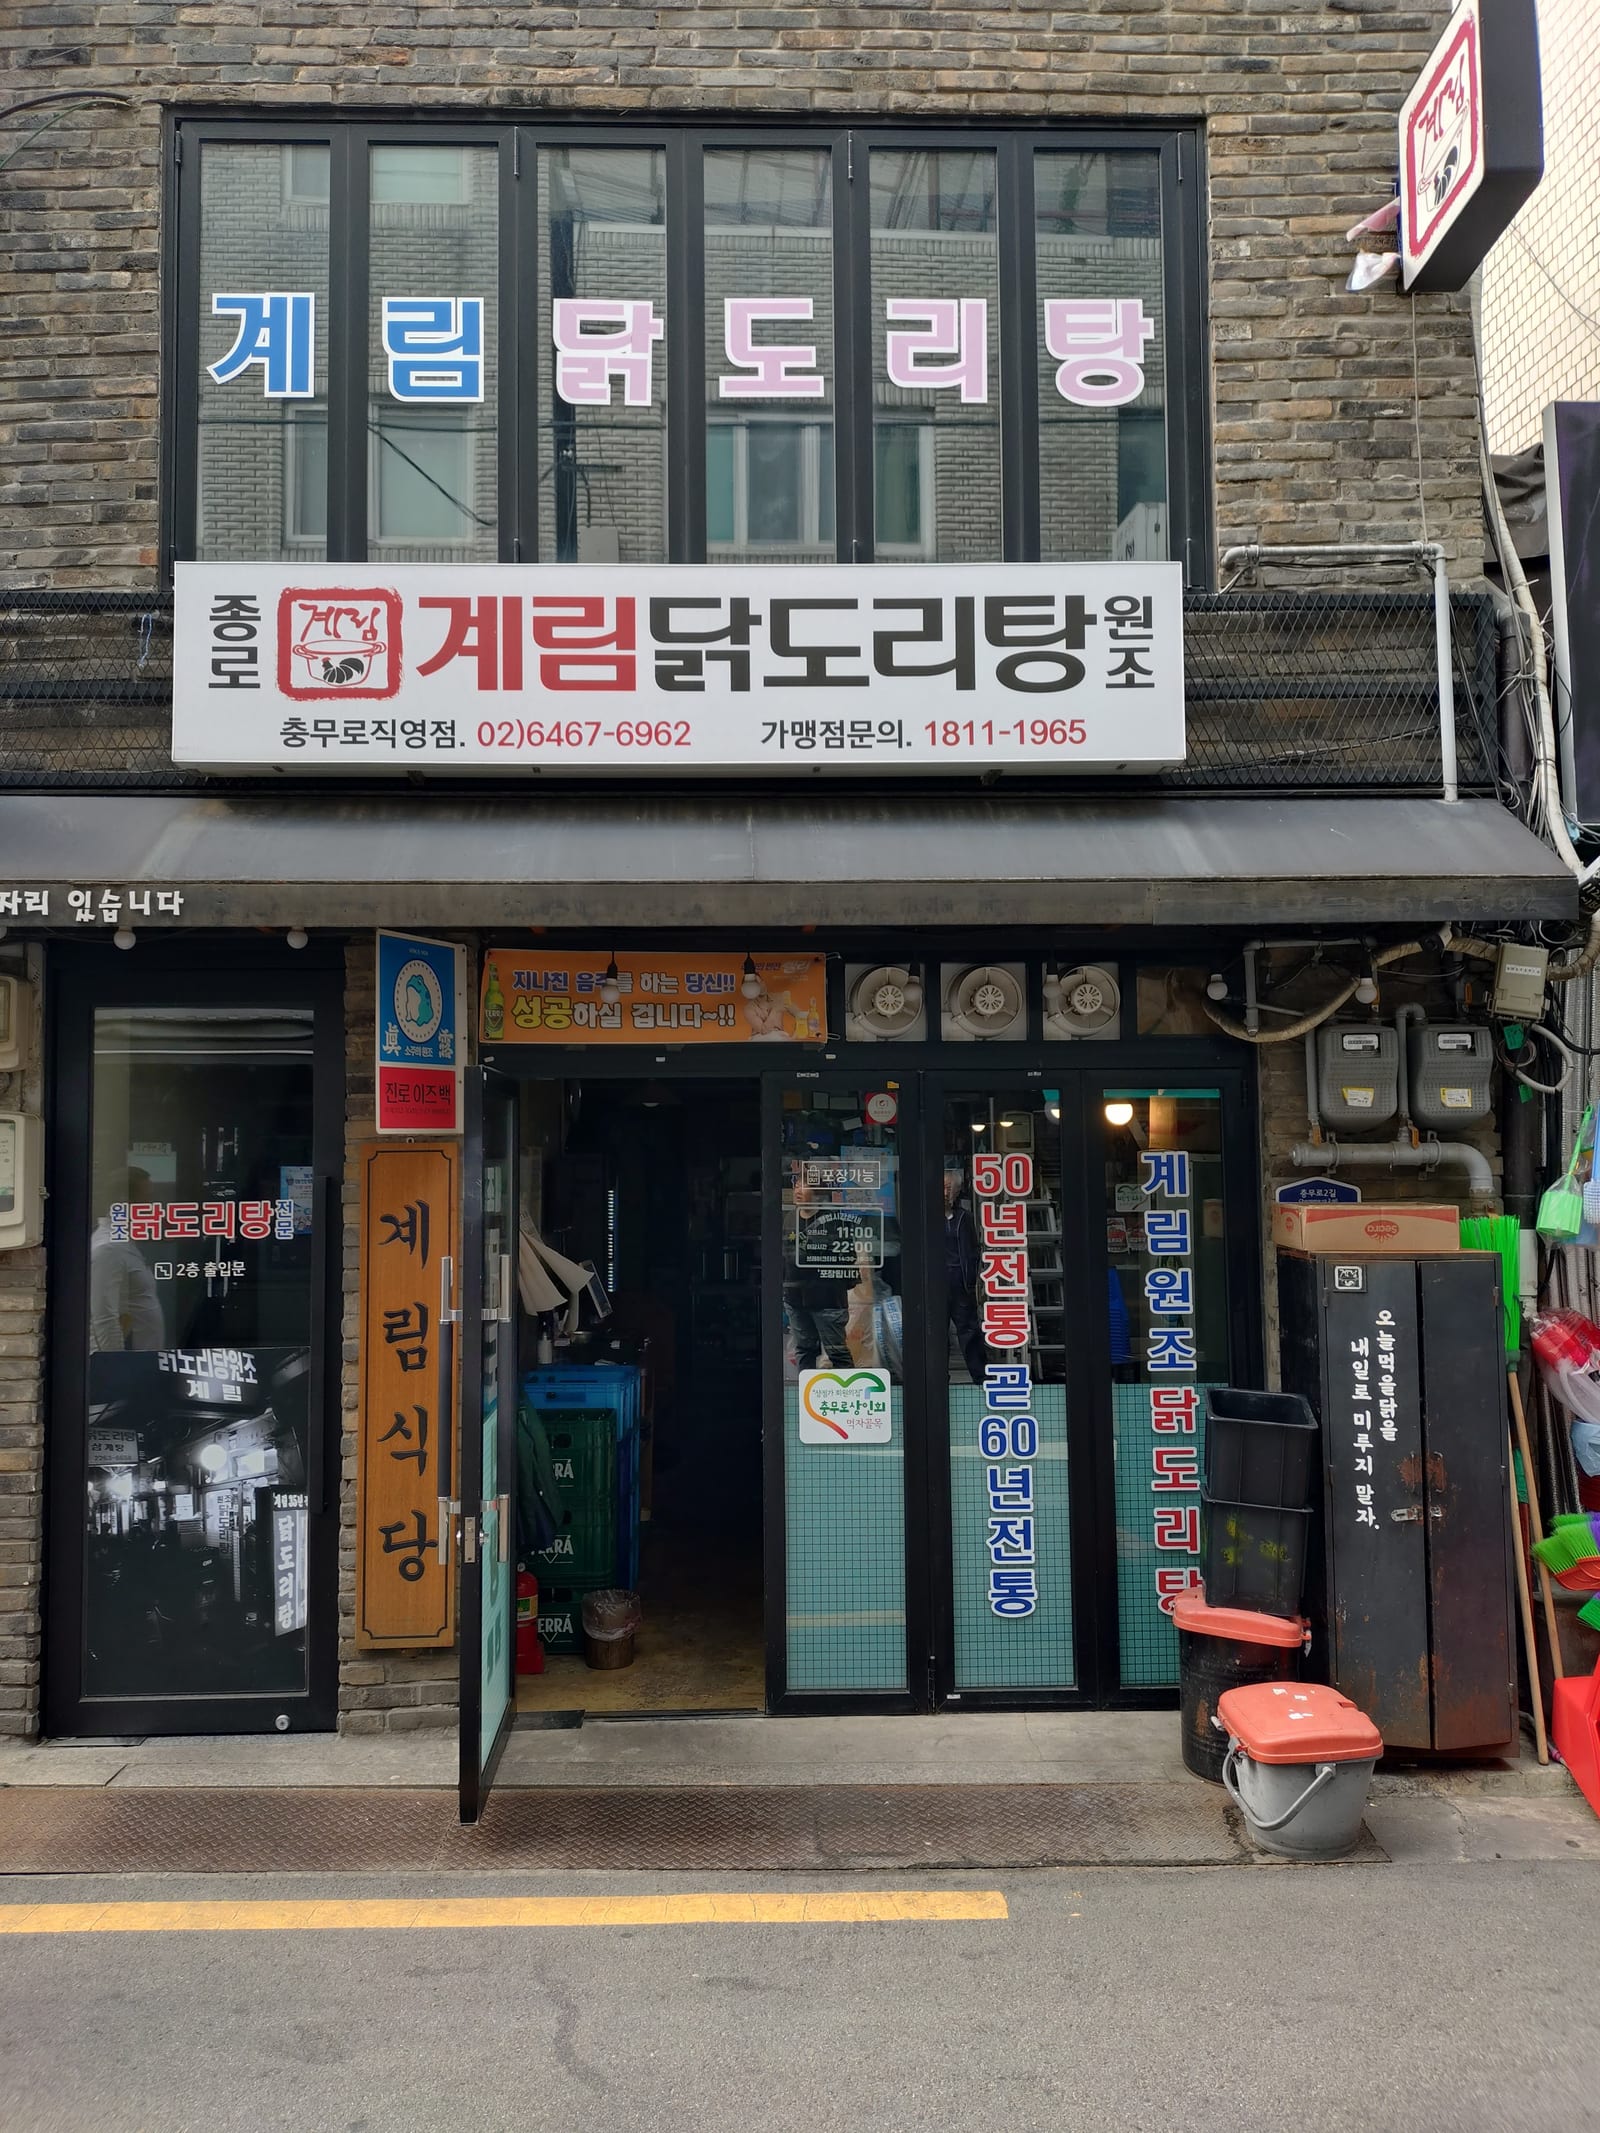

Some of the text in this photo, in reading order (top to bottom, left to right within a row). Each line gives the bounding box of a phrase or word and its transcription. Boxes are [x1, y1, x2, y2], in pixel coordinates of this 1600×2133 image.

[299, 603, 381, 641] 계림
[208, 595, 261, 690] 종로
[1103, 594, 1156, 691] 원조
[279, 717, 1088, 751] 충무로직영점. 02)6467-6962 가맹점문의. 1811-1965
[67, 889, 185, 923] 있습니다
[512, 971, 569, 992] 지나친
[640, 972, 679, 994] 하는
[684, 973, 736, 994] 당신!!
[511, 994, 623, 1030] 성공하실
[384, 1083, 452, 1106] 진로 이즈 백
[822, 1169, 875, 1183] 포장가능
[130, 1200, 274, 1241] 닭도리탕
[837, 1226, 874, 1239] 11:00
[832, 1241, 873, 1254] 22:00
[176, 1261, 246, 1278] 2층 출입문
[1351, 1337, 1373, 1401] 내일로
[819, 1400, 886, 1416] 충무로상인회
[1353, 1409, 1374, 1477] 미루지
